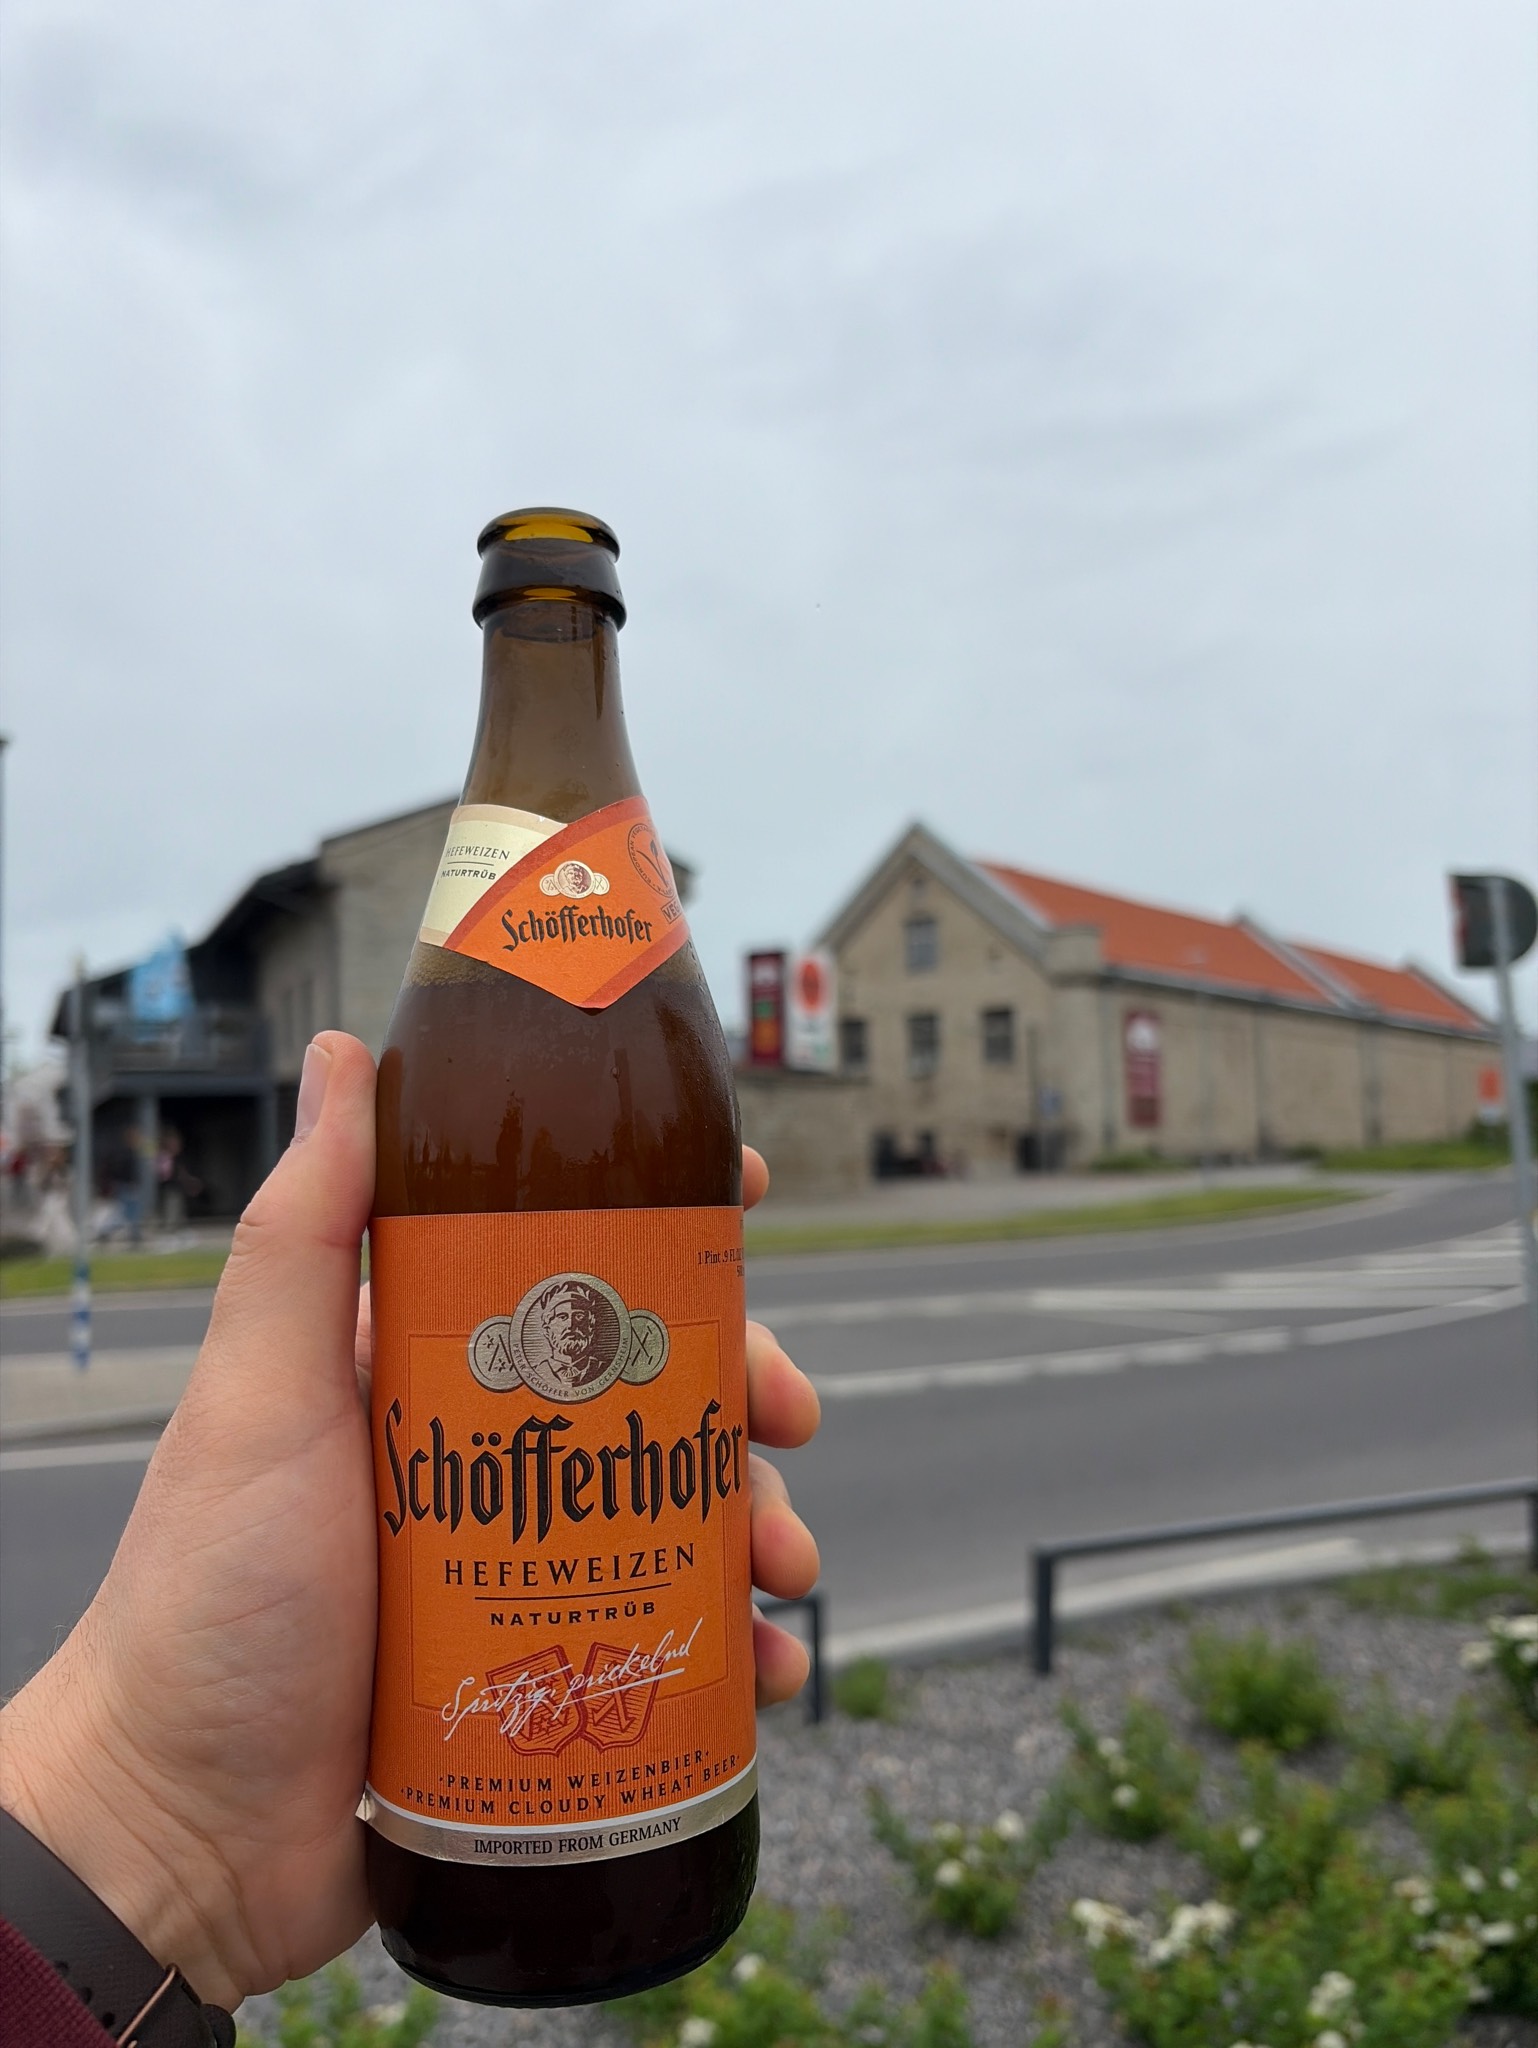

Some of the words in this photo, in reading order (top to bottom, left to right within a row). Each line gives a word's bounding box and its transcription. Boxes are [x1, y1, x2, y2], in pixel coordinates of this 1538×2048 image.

[446, 846, 510, 860] HEFEWEIZEN
[441, 869, 496, 880] NATURTRÜB
[501, 905, 653, 952] Schöfferhofer
[705, 1251, 720, 1264] Pint
[514, 1343, 526, 1370] PETER
[527, 1373, 569, 1397] SCHÖFFER
[575, 1387, 594, 1397] VON
[599, 1338, 628, 1386] GERNSHEIM
[384, 1398, 743, 1544] Schöfferhofer
[444, 1543, 694, 1587] HEFEWEIZEN
[490, 1602, 656, 1626] NATURTRÜB
[509, 1795, 606, 1815] CLOUDY
[620, 1774, 693, 1804] WHEAT
[474, 1839, 553, 1855] IMPORTED
[558, 1834, 604, 1852] FROM
[608, 1817, 682, 1846] GERMANY
